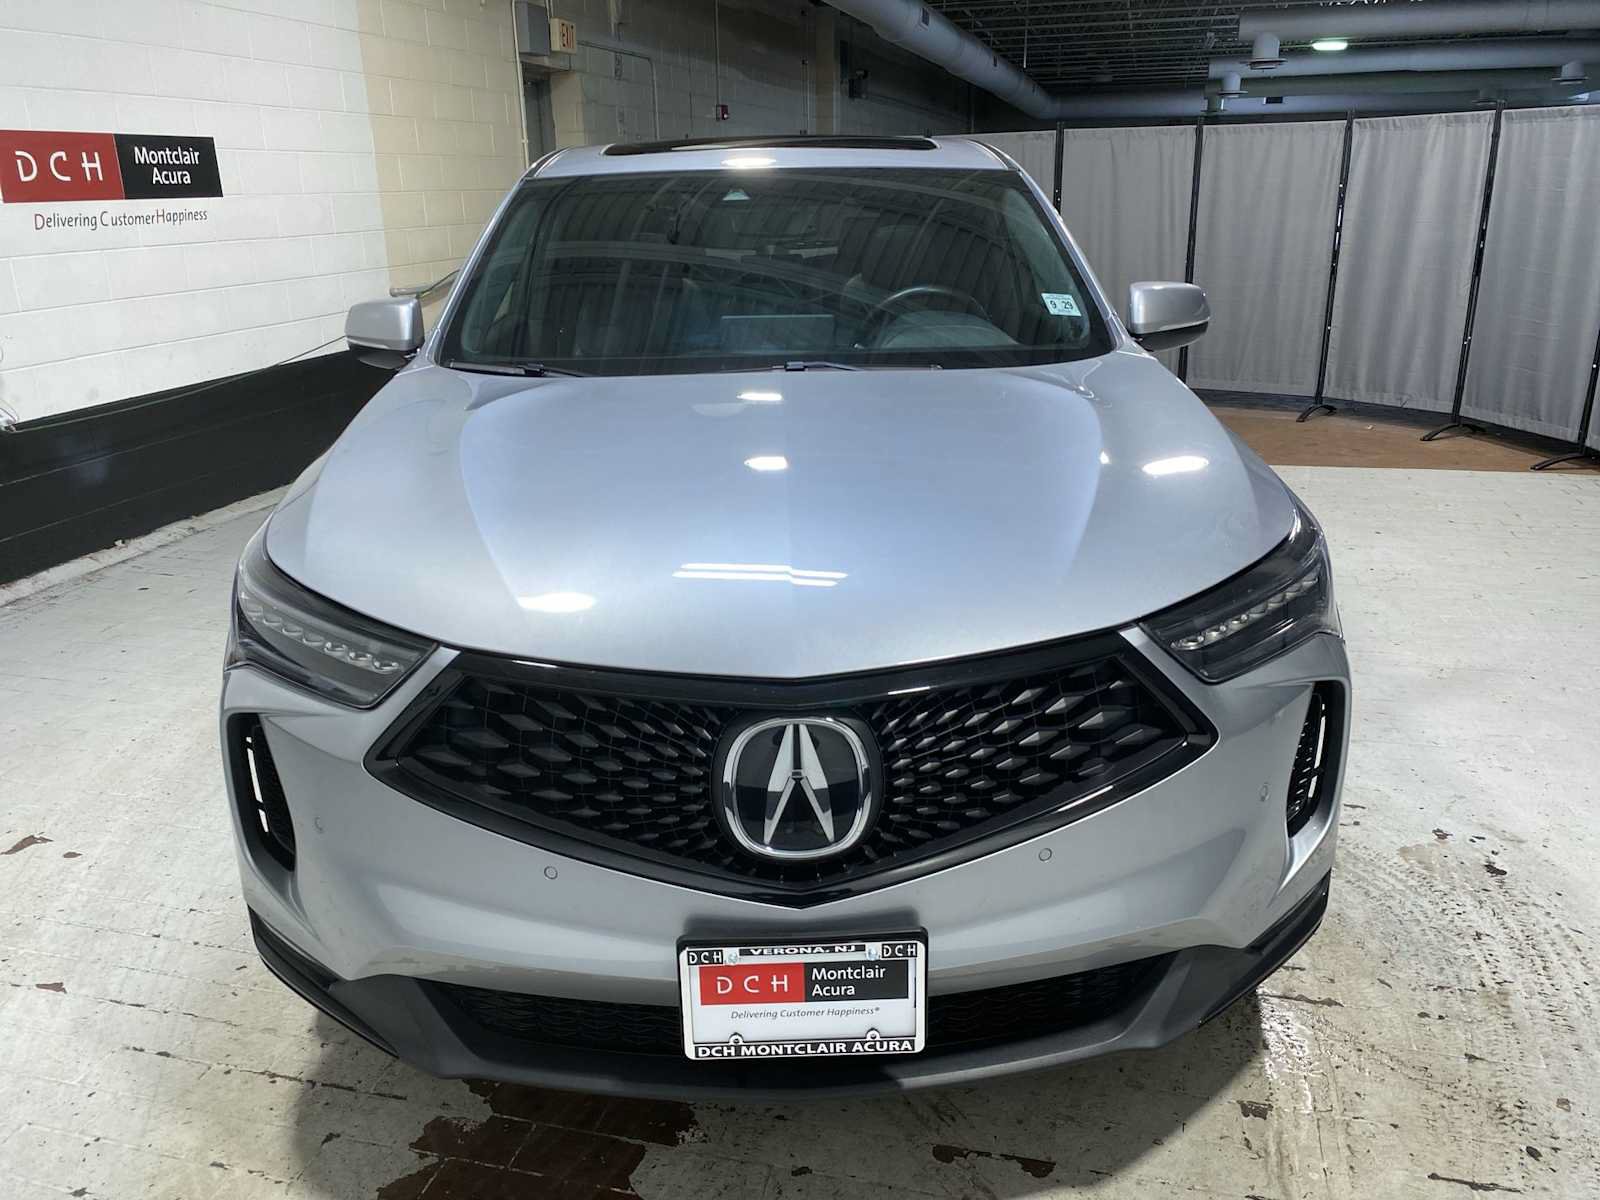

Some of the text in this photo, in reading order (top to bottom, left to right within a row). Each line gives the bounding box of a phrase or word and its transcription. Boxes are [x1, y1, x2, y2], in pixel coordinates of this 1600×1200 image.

[133, 146, 200, 165] Montclair
[15, 150, 104, 182] DCH
[152, 166, 192, 185] Acura
[34, 210, 98, 231] Delivering
[688, 952, 723, 964] DCH
[883, 944, 916, 957] DCH
[811, 965, 886, 981] Montclair
[716, 974, 789, 995] DCH
[811, 983, 856, 997] Acura
[730, 1009, 779, 1020] Delivering
[780, 1008, 825, 1018] Customer
[698, 1040, 913, 1057] DCH MONTCLAIR ACURA
